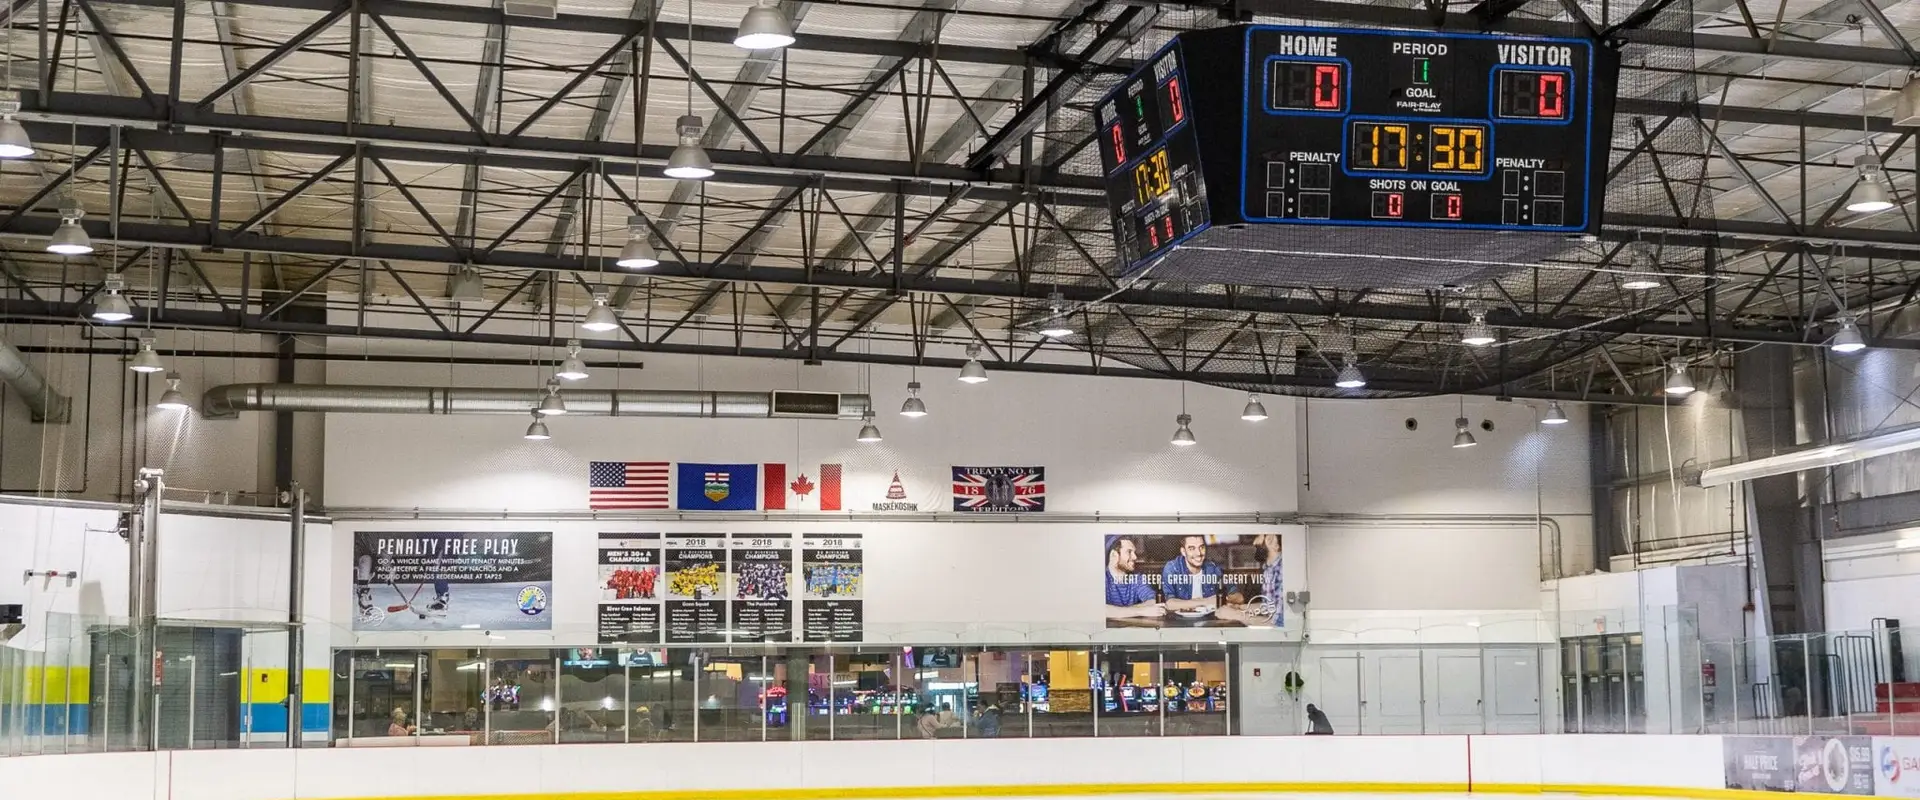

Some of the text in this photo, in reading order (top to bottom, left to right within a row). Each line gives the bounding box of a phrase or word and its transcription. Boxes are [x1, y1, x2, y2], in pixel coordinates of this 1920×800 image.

[1280, 35, 1337, 57] HOME
[1392, 42, 1447, 55] PERIOD
[1497, 44, 1572, 66] VISITOR
[1153, 50, 1178, 82] VISITOR
[1315, 66, 1338, 107] 0
[1405, 88, 1436, 98] GOAL
[1539, 75, 1562, 116] 0
[1168, 77, 1184, 122] 0
[1290, 152, 1340, 162] PENALTY
[1371, 126, 1482, 170] 17:30
[1495, 158, 1545, 169] PENALTY
[1136, 150, 1170, 205] 17:30
[1369, 180, 1461, 191] SHOTS ON GOAL
[1389, 194, 1401, 216] 0
[1447, 196, 1460, 217] 0
[965, 467, 1005, 475] TREATY
[1020, 486, 1036, 495] 76
[378, 538, 519, 555] PENALTY FREE PLAY
[1167, 574, 1193, 584] GREAT
[1223, 574, 1248, 584] GREAT
